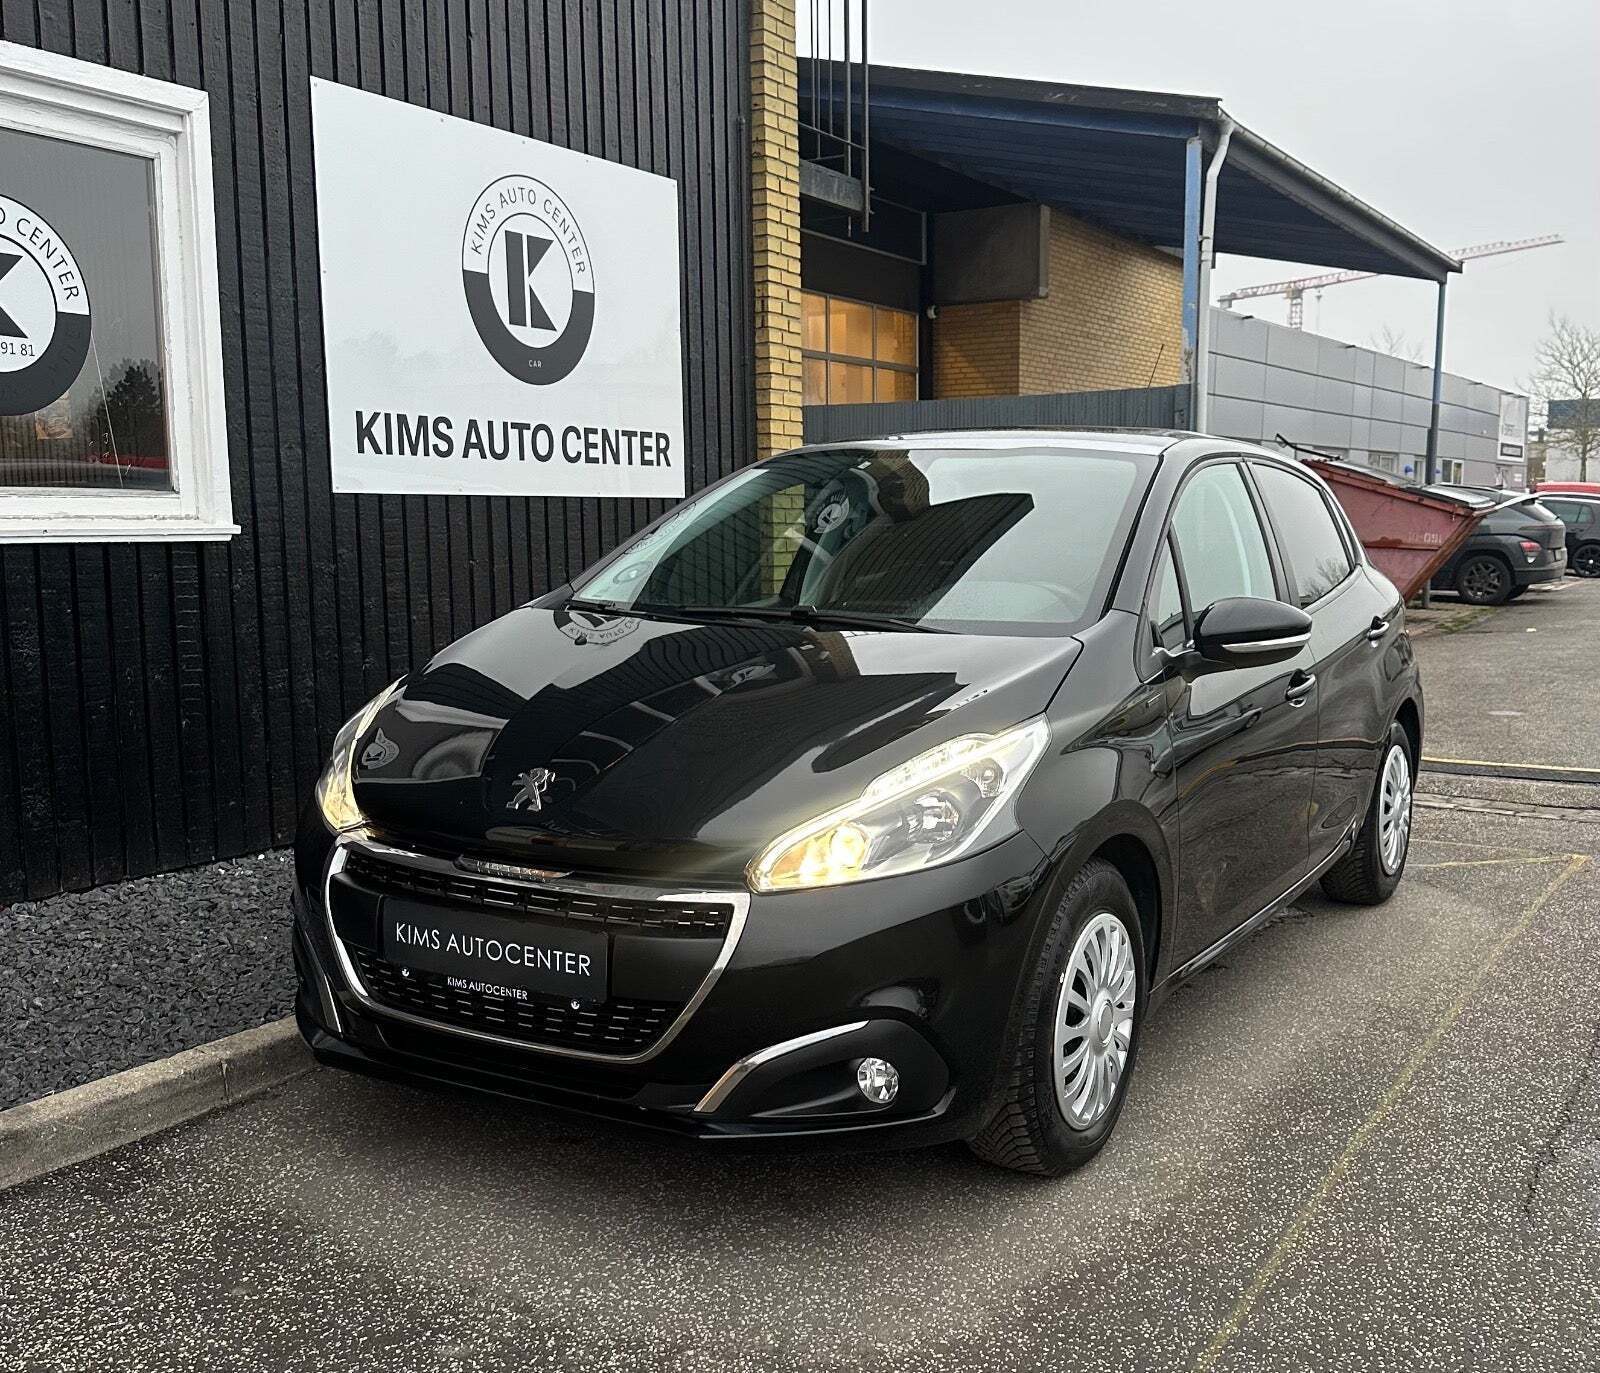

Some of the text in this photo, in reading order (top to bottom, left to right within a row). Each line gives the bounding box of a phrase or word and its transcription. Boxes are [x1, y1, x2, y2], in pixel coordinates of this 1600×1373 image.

[471, 186, 586, 274] KIMS AUTO CENTER
[16, 217, 80, 301] CENTER
[504, 229, 557, 332] K
[20, 343, 36, 357] 81
[528, 359, 543, 369] CAR
[355, 410, 672, 467] KIMS AUTO CENTER
[396, 922, 591, 977] KIMS AUTOCENTER
[447, 976, 528, 1001] KIMS AUTOCENTER
